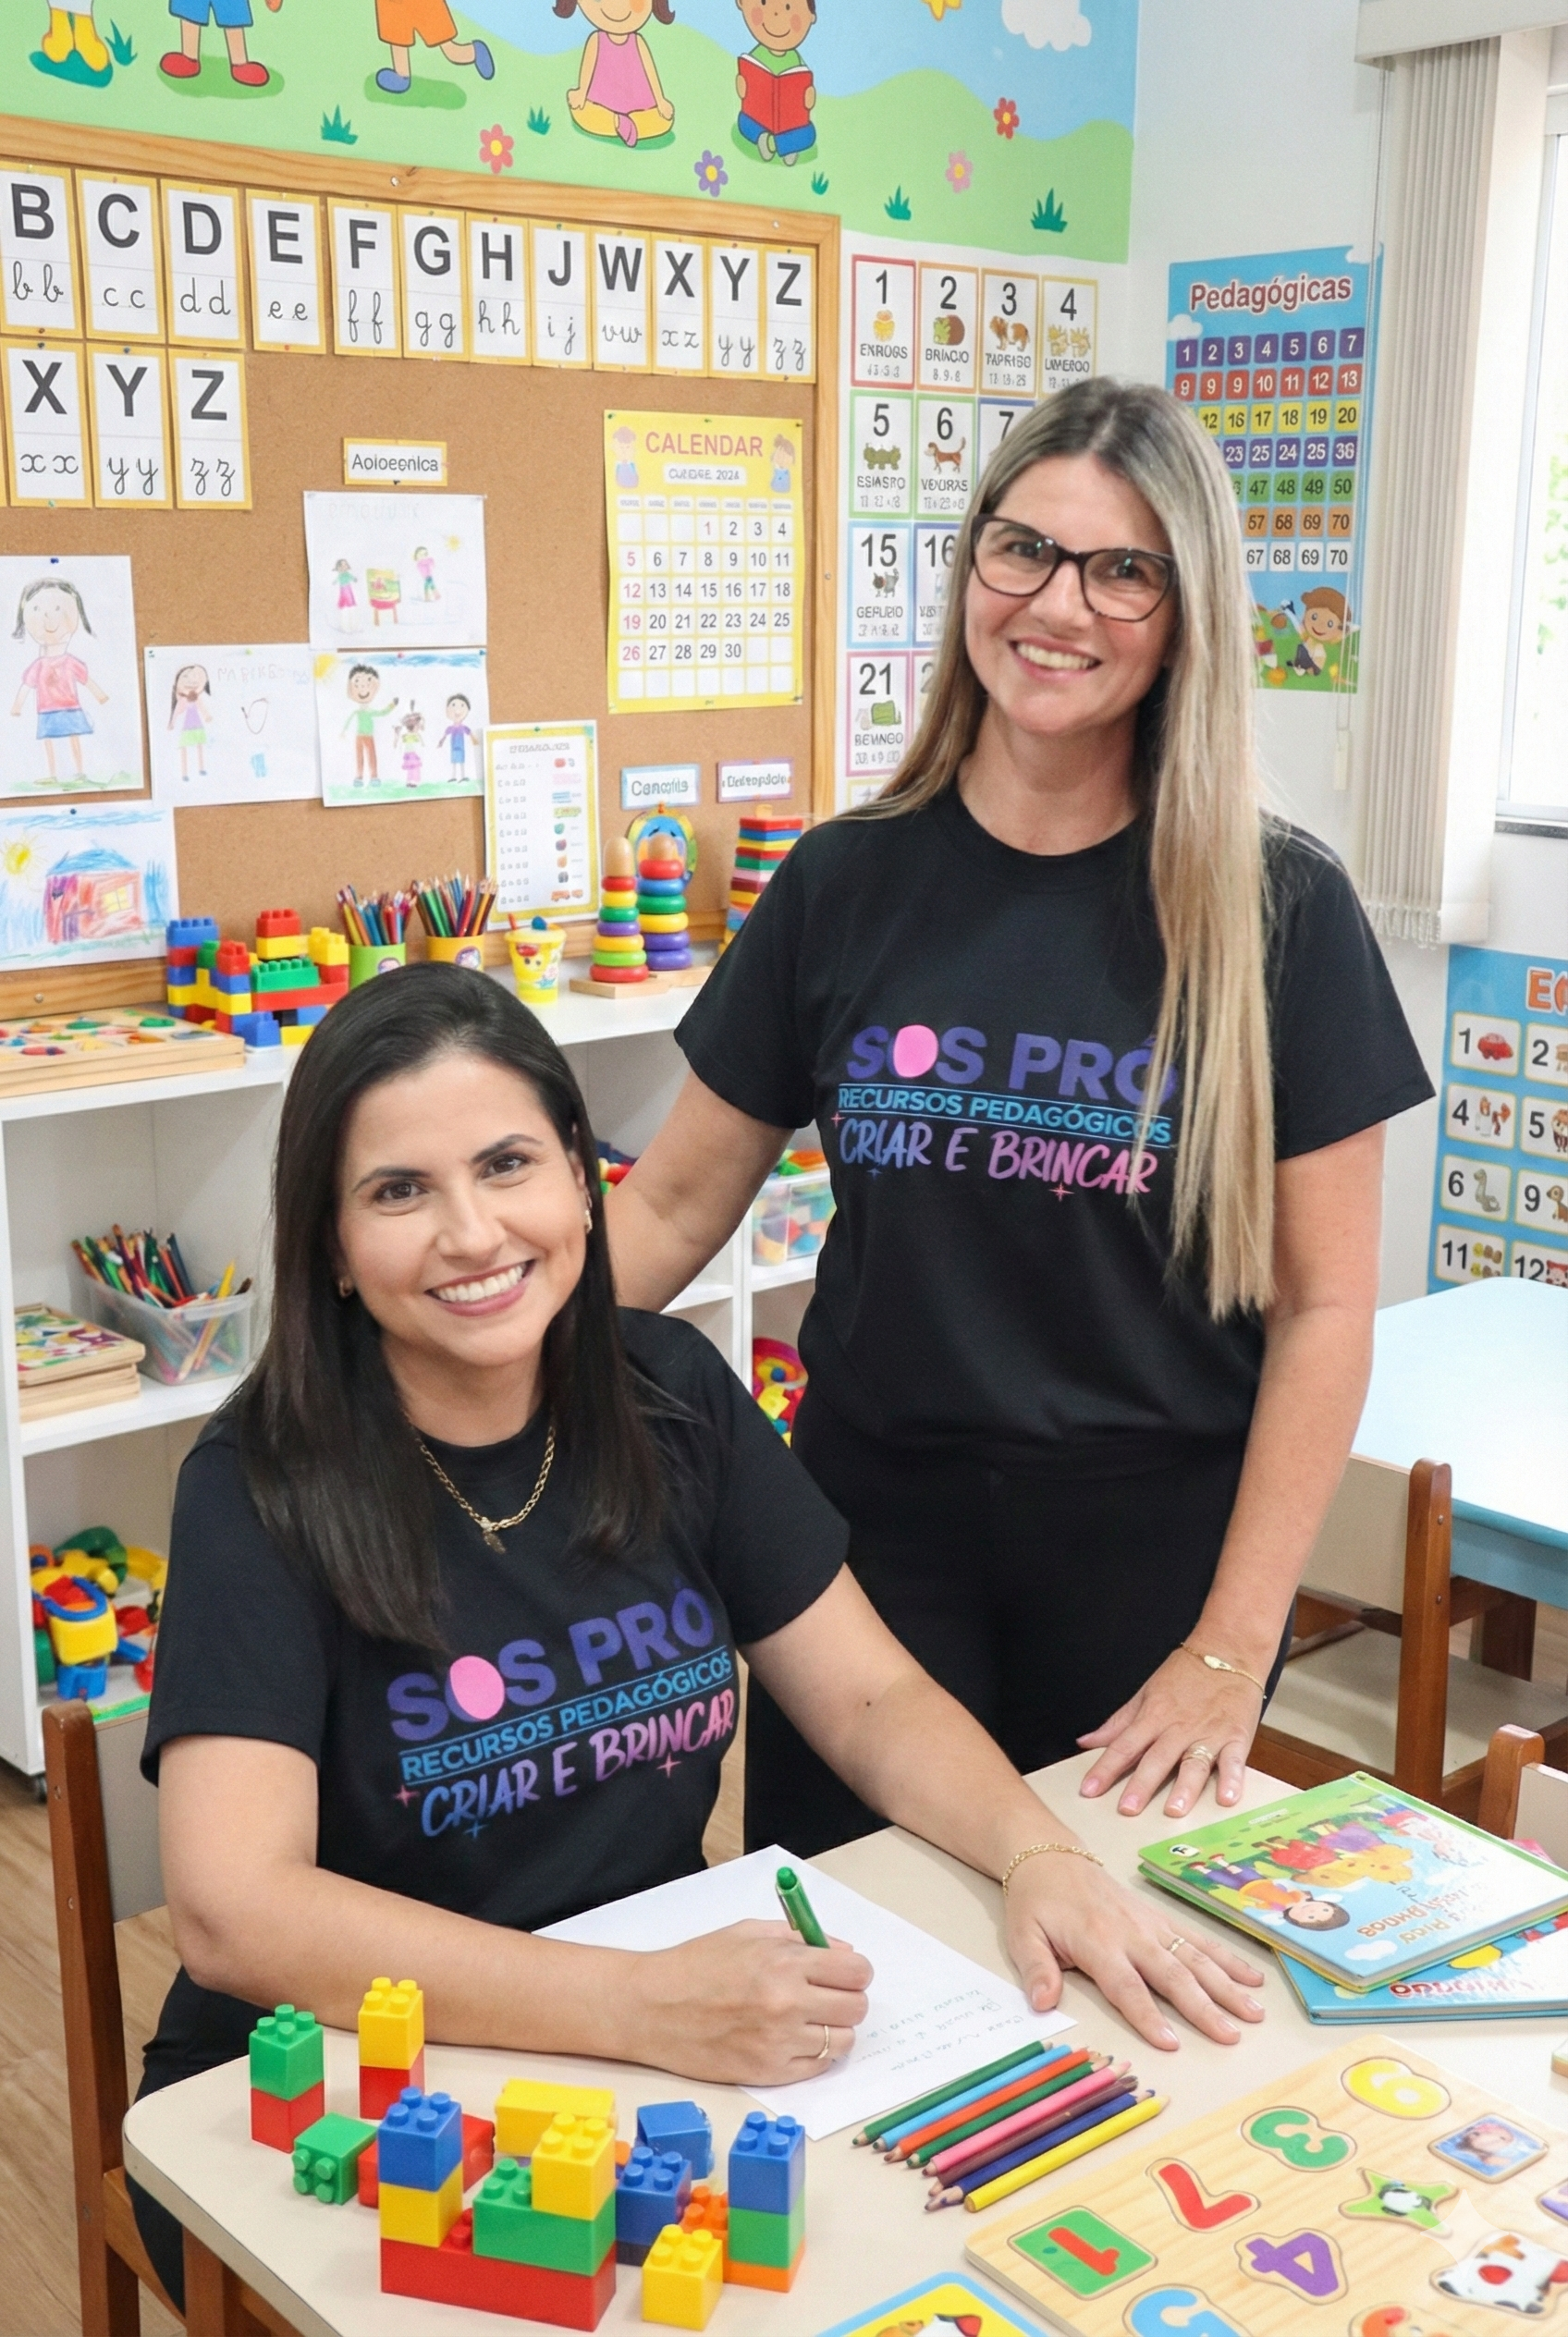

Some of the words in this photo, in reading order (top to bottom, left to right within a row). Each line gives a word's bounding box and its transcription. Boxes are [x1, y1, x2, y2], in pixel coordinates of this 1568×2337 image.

[11, 182, 55, 239] B
[97, 193, 140, 248] C
[181, 201, 223, 255] D
[267, 209, 303, 264] E
[349, 218, 377, 269] F
[413, 226, 451, 275] G
[482, 231, 513, 281] H
[547, 240, 571, 287] J
[598, 243, 643, 292] W
[664, 250, 695, 299] X
[720, 255, 751, 301] Y
[775, 262, 802, 307] Z
[876, 269, 888, 305] 1
[940, 275, 957, 310] 2
[1001, 282, 1017, 316] 3
[1060, 288, 1077, 321] 4
[1190, 275, 1352, 313] Pedagógicas
[1182, 346, 1190, 361] 1
[1207, 344, 1218, 361] 2
[1234, 342, 1244, 359] 3
[1261, 340, 1271, 357] 4
[1289, 338, 1299, 356] 5
[1317, 336, 1328, 354] 6
[1347, 335, 1357, 352] 7
[21, 359, 67, 415] X
[105, 363, 148, 418] Y
[190, 369, 227, 422] Z
[1207, 378, 1216, 395] 9
[1233, 376, 1243, 394] 9
[1256, 374, 1273, 392] 10
[1285, 373, 1299, 391] 11
[1312, 372, 1329, 389] 12
[1341, 370, 1358, 387] 13
[873, 403, 889, 436] 5
[937, 407, 953, 440] 6
[998, 410, 1014, 441] 7
[1255, 410, 1271, 427] 17
[1281, 409, 1299, 425] 18
[1309, 408, 1328, 424] 19
[1338, 407, 1357, 423] 20
[645, 431, 764, 457] CALENDAR
[1279, 444, 1297, 460] 24
[1249, 480, 1268, 495] 47
[1277, 479, 1295, 495] 48
[1305, 479, 1324, 495] 49
[1333, 478, 1353, 495] 50
[705, 521, 711, 535] 1
[729, 521, 739, 536] 2
[753, 522, 763, 536] 3
[778, 522, 787, 536] 4
[1303, 514, 1321, 530] 69
[1331, 514, 1350, 530] 70
[627, 551, 636, 567] 5
[653, 552, 662, 567] 6
[679, 552, 688, 567] 7
[704, 552, 713, 567] 8
[729, 552, 739, 567] 9
[751, 552, 766, 567] 10
[776, 552, 790, 567] 11
[861, 533, 898, 568] 15
[925, 533, 955, 569] 16
[1246, 549, 1264, 565] 67
[1273, 549, 1292, 565] 68
[1301, 549, 1320, 565] 69
[1329, 549, 1348, 566] 70
[625, 583, 641, 598] 12
[650, 582, 667, 598] 13
[676, 582, 692, 598] 14
[701, 582, 717, 598] 15
[726, 582, 742, 598] 16
[750, 582, 766, 597] 17
[775, 582, 790, 597] 18
[624, 614, 641, 630] 19
[649, 614, 667, 630] 20
[675, 614, 691, 629] 21
[700, 613, 717, 629] 22
[725, 613, 741, 628] 23
[750, 612, 766, 628] 24
[774, 612, 790, 628] 25
[622, 645, 641, 661] 26
[649, 645, 667, 660] 27
[675, 644, 692, 659] 28
[700, 644, 717, 658] 29
[725, 643, 741, 658] 30
[859, 662, 891, 695] 21
[846, 1024, 987, 1084] SOS
[1008, 1033, 1178, 1107] PRÓ
[1458, 1027, 1471, 1054] 1
[1532, 1039, 1549, 1067] 2
[838, 1087, 962, 1116] RECURSOS
[969, 1096, 1171, 1144] PEDAGÓGICOS
[1452, 1099, 1469, 1126] 4
[1528, 1111, 1545, 1139] 5
[839, 1118, 932, 1168] CRIAR
[945, 1127, 979, 1172] E
[987, 1131, 1158, 1193] BRINCAR
[1448, 1170, 1464, 1197] 6
[1525, 1184, 1540, 1212] 9
[1442, 1240, 1468, 1269] 11
[1514, 1255, 1544, 1281] 12
[386, 1639, 557, 1741] SOS
[401, 1715, 554, 1781] RECURSOS
[559, 1650, 732, 1731] PEDAGÓGICOS
[422, 1759, 541, 1837] CRIAR
[553, 1742, 578, 1796] E
[589, 1689, 735, 1781] BRINCAR
[1249, 2107, 1353, 2169] 3
[1158, 2163, 1253, 2230] 7
[1048, 2226, 1120, 2276] 1
[1245, 2233, 1339, 2298] 4
